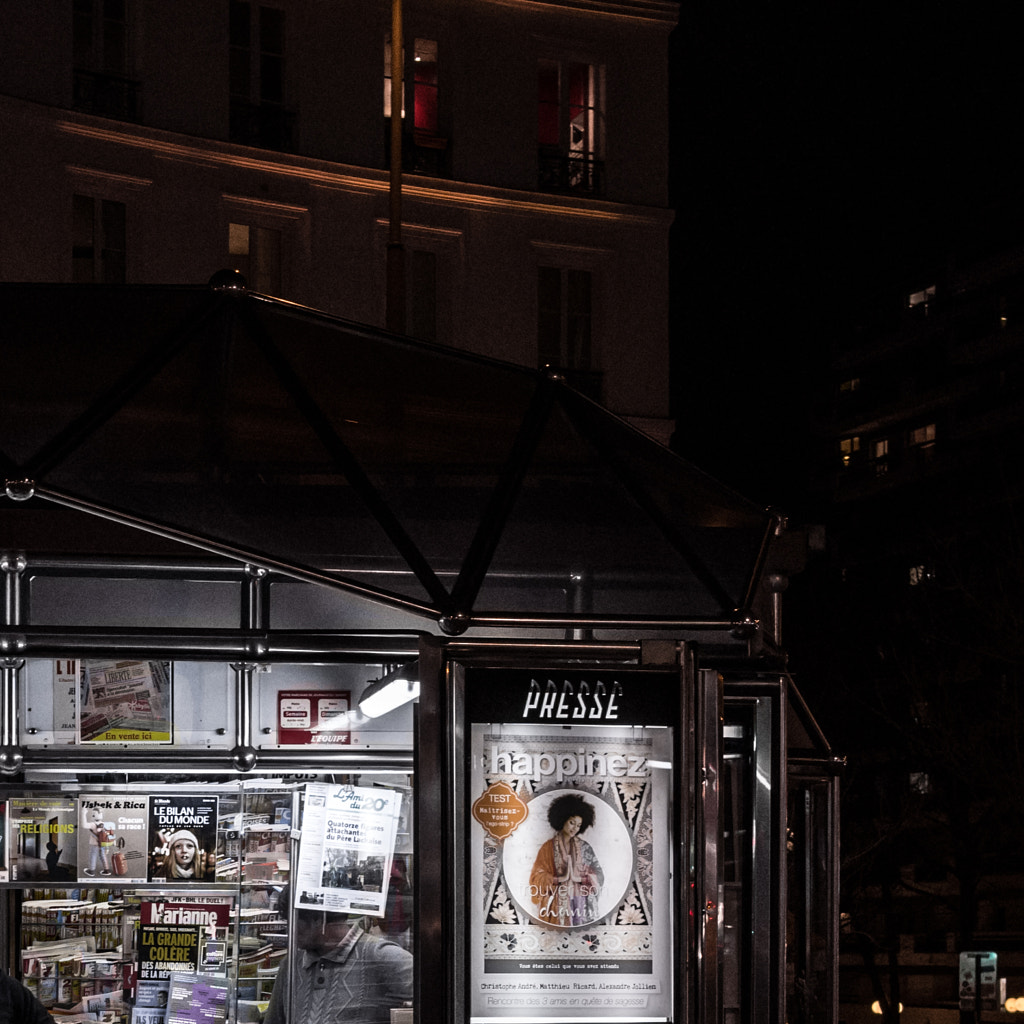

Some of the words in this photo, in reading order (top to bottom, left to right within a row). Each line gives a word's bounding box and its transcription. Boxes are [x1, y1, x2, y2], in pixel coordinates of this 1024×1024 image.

[522, 679, 623, 719] PRESSE
[105, 732, 116, 740] En
[118, 733, 140, 741] vente
[141, 732, 152, 740] ici
[491, 745, 647, 782] happinez
[488, 794, 512, 803] TEST
[113, 801, 122, 809] &
[123, 800, 146, 810] Rica
[153, 806, 166, 816] LE
[166, 806, 194, 816] BILAN
[159, 815, 174, 825] DU
[174, 815, 210, 825] MONDE
[327, 819, 359, 830] Quatorze
[20, 823, 75, 835] RELIGIONS
[150, 902, 218, 926] Marianne
[142, 931, 156, 946] LA
[157, 932, 198, 946] GRANDE
[149, 946, 191, 962] COLÈRE
[141, 961, 154, 970] DES
[480, 982, 517, 991] Christophe
[539, 982, 570, 991] Matthieu
[598, 982, 631, 991] Alexandre
